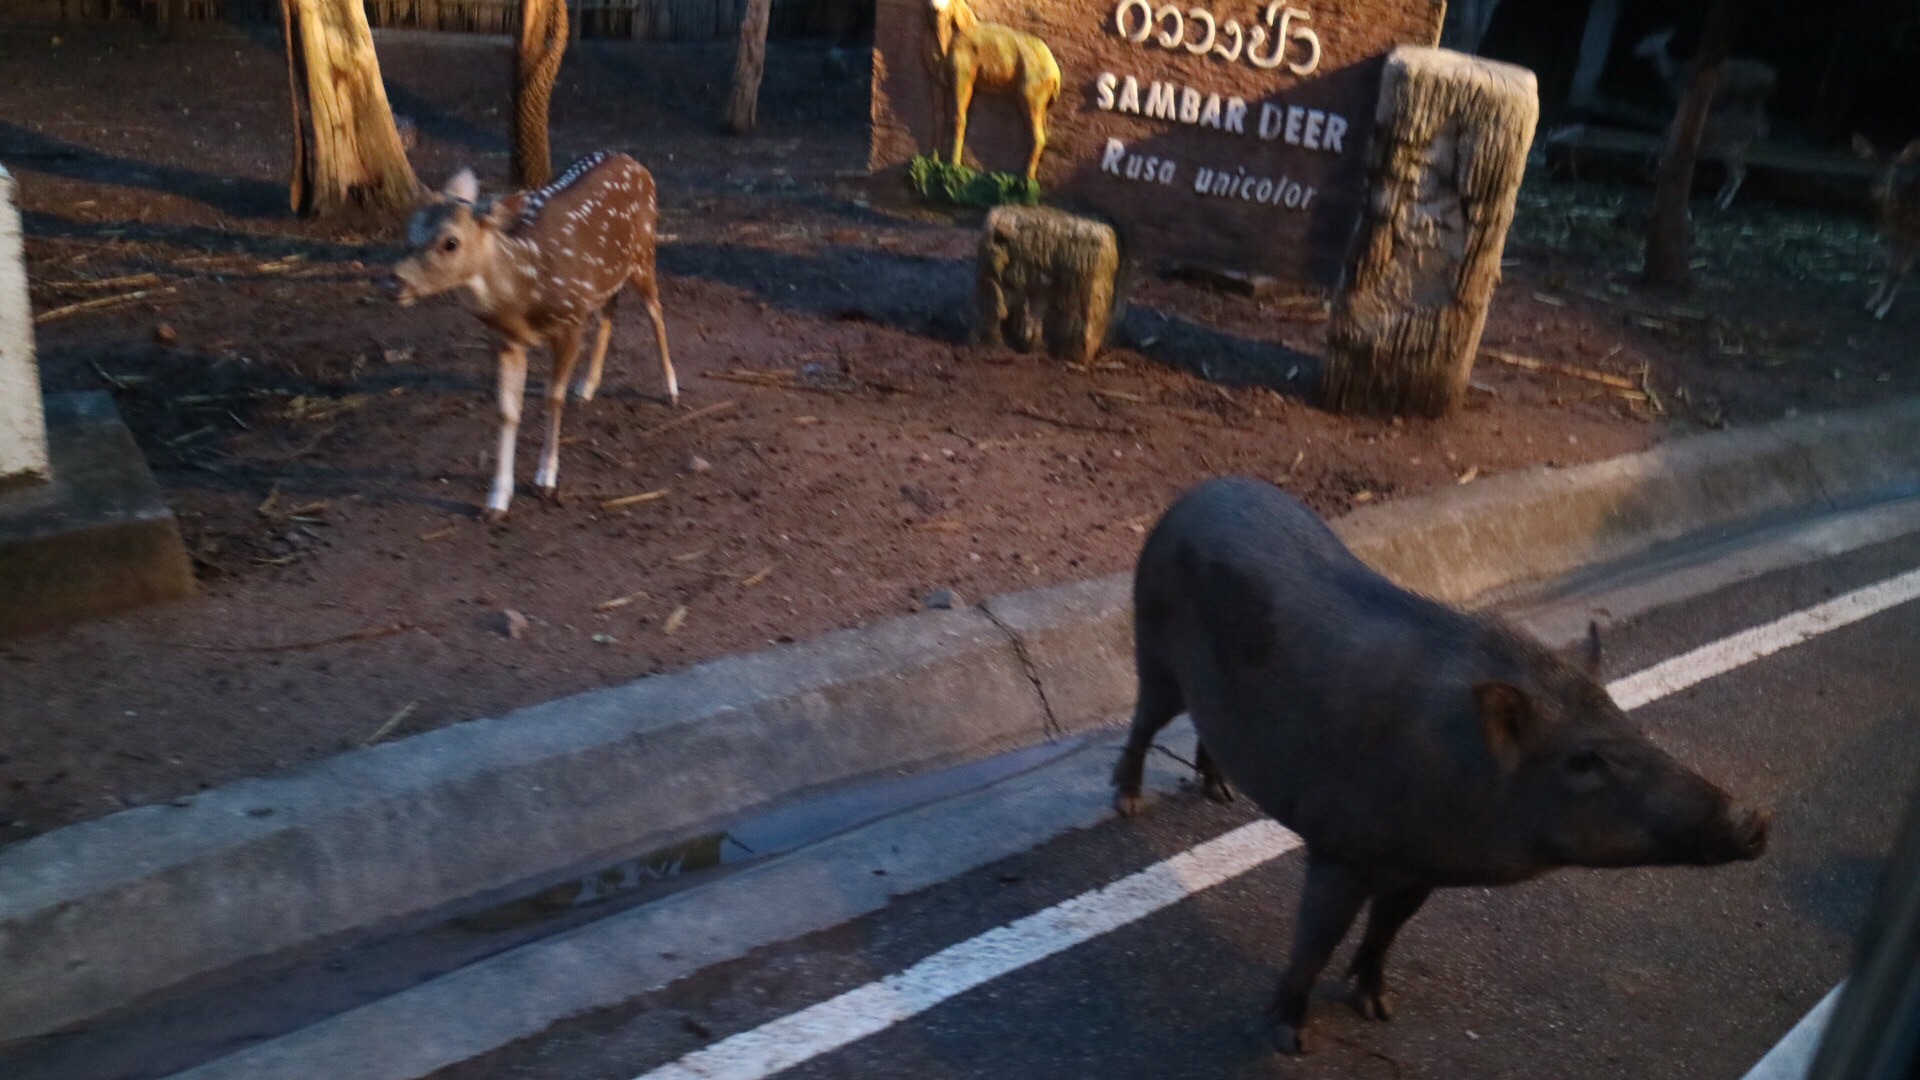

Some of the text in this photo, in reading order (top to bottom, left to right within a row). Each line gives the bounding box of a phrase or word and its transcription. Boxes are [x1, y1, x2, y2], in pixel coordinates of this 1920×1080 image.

[1096, 72, 1348, 153] SAMBAR DEER
[1101, 137, 1317, 209] Rusa unicolor
